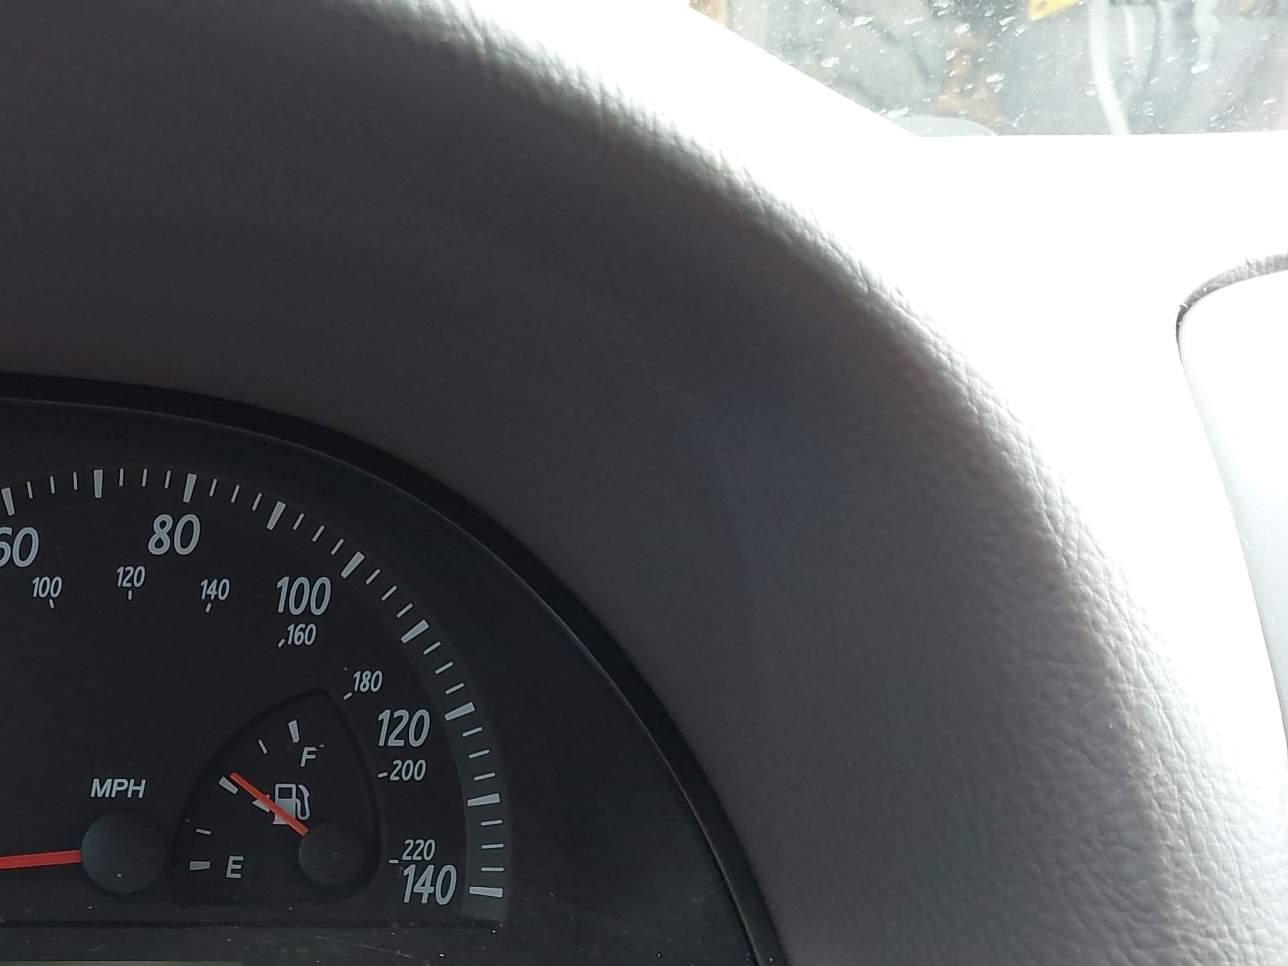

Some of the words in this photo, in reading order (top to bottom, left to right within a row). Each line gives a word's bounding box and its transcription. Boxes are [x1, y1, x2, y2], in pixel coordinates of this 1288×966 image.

[148, 514, 200, 555] 80
[33, 576, 62, 597] 100
[117, 566, 145, 587] 120
[201, 579, 229, 600] 140
[277, 576, 331, 615] 100
[288, 624, 316, 645] 160
[354, 671, 382, 692] 180
[378, 709, 430, 747] 120
[301, 747, 317, 767] F
[390, 760, 426, 780] 200
[91, 779, 146, 798] MPH
[402, 839, 435, 860] 220
[226, 856, 244, 878] E
[401, 864, 456, 905] 140
